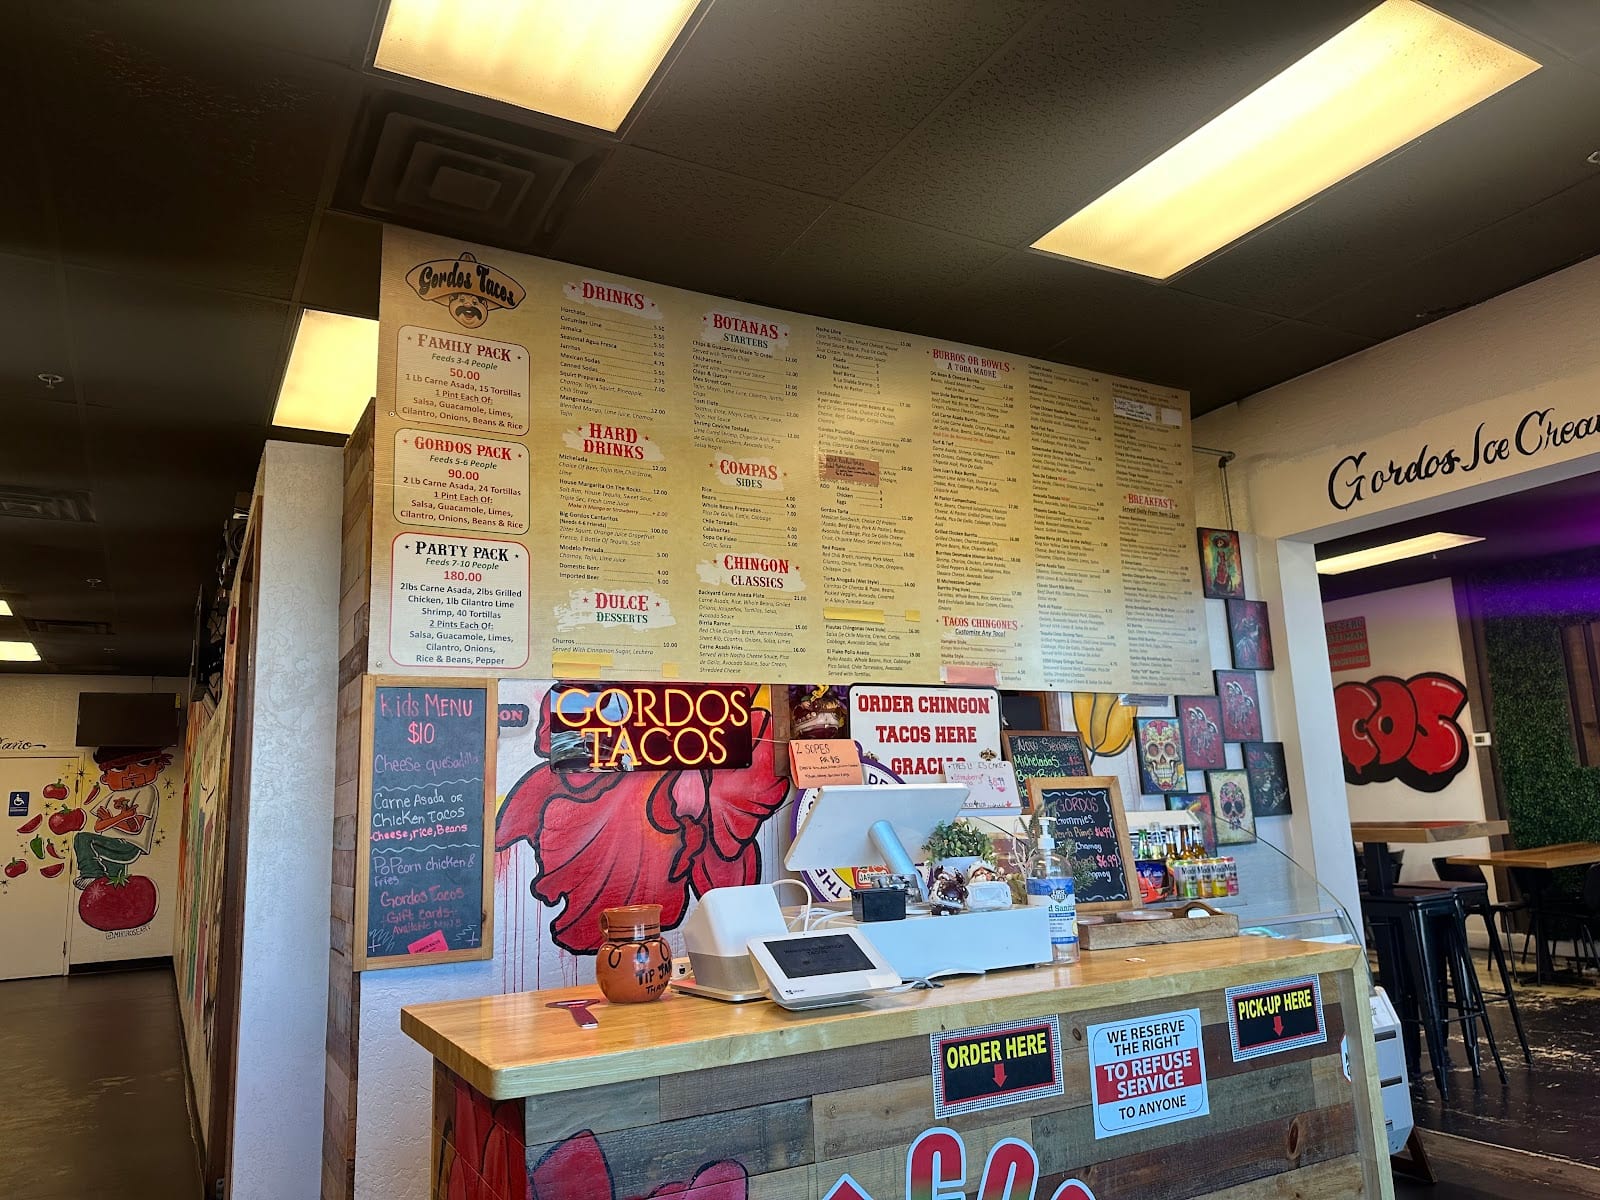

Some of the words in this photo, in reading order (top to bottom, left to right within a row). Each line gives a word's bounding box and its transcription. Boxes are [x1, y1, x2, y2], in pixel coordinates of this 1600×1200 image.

[419, 262, 472, 295] Gordos
[476, 265, 515, 306] Tacos
[582, 282, 644, 310] DRINKS
[714, 314, 778, 339] BOTANAS
[418, 333, 472, 354] FAMILY
[477, 345, 511, 362] PACK
[724, 333, 768, 348] STARTERS
[432, 353, 454, 364] Feeds
[456, 357, 469, 365] 3-4
[471, 360, 498, 370] People
[933, 349, 965, 363] BURROS
[968, 356, 978, 365] OR
[982, 359, 1010, 372] BOWLS
[450, 368, 480, 381] 50.00
[955, 364, 971, 374] TODA
[974, 368, 996, 378] MADRE
[413, 374, 422, 382] Lb
[424, 376, 448, 386] Carne
[451, 380, 477, 392] Asada,
[491, 386, 521, 398] Tortillas
[413, 397, 436, 407] Salsa,
[439, 400, 486, 415] Guacamole,
[489, 408, 513, 418] Limes,
[402, 406, 437, 419] Cilantro,
[440, 412, 470, 423] Onions,
[473, 416, 496, 426] Beans
[507, 421, 523, 429] Rice
[589, 423, 637, 443] HARD
[415, 436, 472, 454] GORDOS
[477, 445, 512, 460] PACK
[584, 439, 644, 459] DRINKS
[430, 455, 452, 465] Feeds
[470, 459, 497, 470] People
[720, 460, 777, 480] COMPAS
[1328, 445, 1460, 511] Gordos
[1462, 422, 1509, 471] Ice
[448, 469, 479, 481] 90.00
[736, 478, 762, 488] SIDES
[423, 478, 447, 488] Carne
[449, 481, 476, 492] Asada,
[478, 484, 488, 492] 24
[491, 486, 521, 495] Tortillas
[412, 500, 435, 510] Salsa,
[438, 503, 486, 515] Guacamole,
[488, 507, 514, 517] Limes,
[1129, 494, 1174, 509] BREAKFAST
[400, 510, 437, 522] Cilantro,
[439, 514, 470, 525] Onions,
[473, 518, 496, 526] Beans
[508, 521, 523, 529] Rice
[416, 541, 469, 558] PARTY
[474, 547, 509, 562] PACK
[426, 558, 449, 567] Feeds
[452, 560, 470, 568] 7-10
[472, 561, 499, 571] People
[724, 555, 789, 573] CHINGON
[444, 571, 482, 582] 180.00
[731, 575, 783, 588] CLASSICS
[400, 583, 418, 591] 2lbs
[420, 584, 444, 593] Carne
[447, 586, 475, 596] Asada,
[477, 588, 493, 596] 2lbs
[496, 589, 522, 597] Grilled
[408, 596, 443, 605] Chicken,
[446, 597, 459, 605] 1lb
[461, 598, 493, 606] Cilantro
[496, 600, 514, 608] Lime
[595, 592, 648, 611] DULCE
[422, 608, 454, 617] Shrimp,
[469, 610, 501, 619] Tortillas
[597, 612, 648, 623] DESSERTS
[942, 616, 968, 626] TACOS
[972, 618, 1018, 630] CHINGONES
[410, 631, 434, 639] Salsa,
[436, 632, 486, 642] Guacamole,
[488, 634, 514, 643] Limes,
[426, 644, 461, 653] Cilantro,
[464, 645, 495, 653] Onions,
[446, 656, 473, 664] Beans,
[475, 657, 504, 665] Pepper
[380, 692, 419, 717] Kids
[425, 693, 472, 718] MENU
[556, 688, 748, 727] GORDOS
[858, 695, 913, 712] ORDER
[918, 696, 990, 713] CHINGON
[408, 722, 434, 744] $10
[876, 726, 930, 743] TACOS
[935, 727, 976, 743] HERE
[580, 728, 727, 766] TACOS
[795, 743, 802, 754] 2
[375, 754, 421, 774] Cheese
[891, 758, 965, 775] GRACI
[374, 793, 411, 810] Carne
[414, 789, 444, 804] Asada
[1056, 797, 1098, 812] GORDOS
[1096, 854, 1118, 868] $6.99
[815, 868, 842, 898] THE
[381, 891, 428, 908] Gordos
[430, 885, 464, 900] Tacos
[636, 969, 654, 985] TIP
[1238, 996, 1280, 1020] PICK-UP
[1284, 989, 1312, 1008] HERE
[1107, 1030, 1127, 1043] WE
[1131, 1020, 1184, 1038] RESERVE
[947, 1040, 1001, 1069] ORDER
[1006, 1032, 1046, 1056] HERE
[1114, 1041, 1139, 1056] THE
[1142, 1035, 1179, 1050] RIGHT
[1104, 1064, 1129, 1082] TO
[1132, 1051, 1192, 1077] REFUSE
[1117, 1071, 1184, 1099] SERVICE
[1119, 1106, 1136, 1119] TO
[1139, 1095, 1186, 1116] ANYONE
